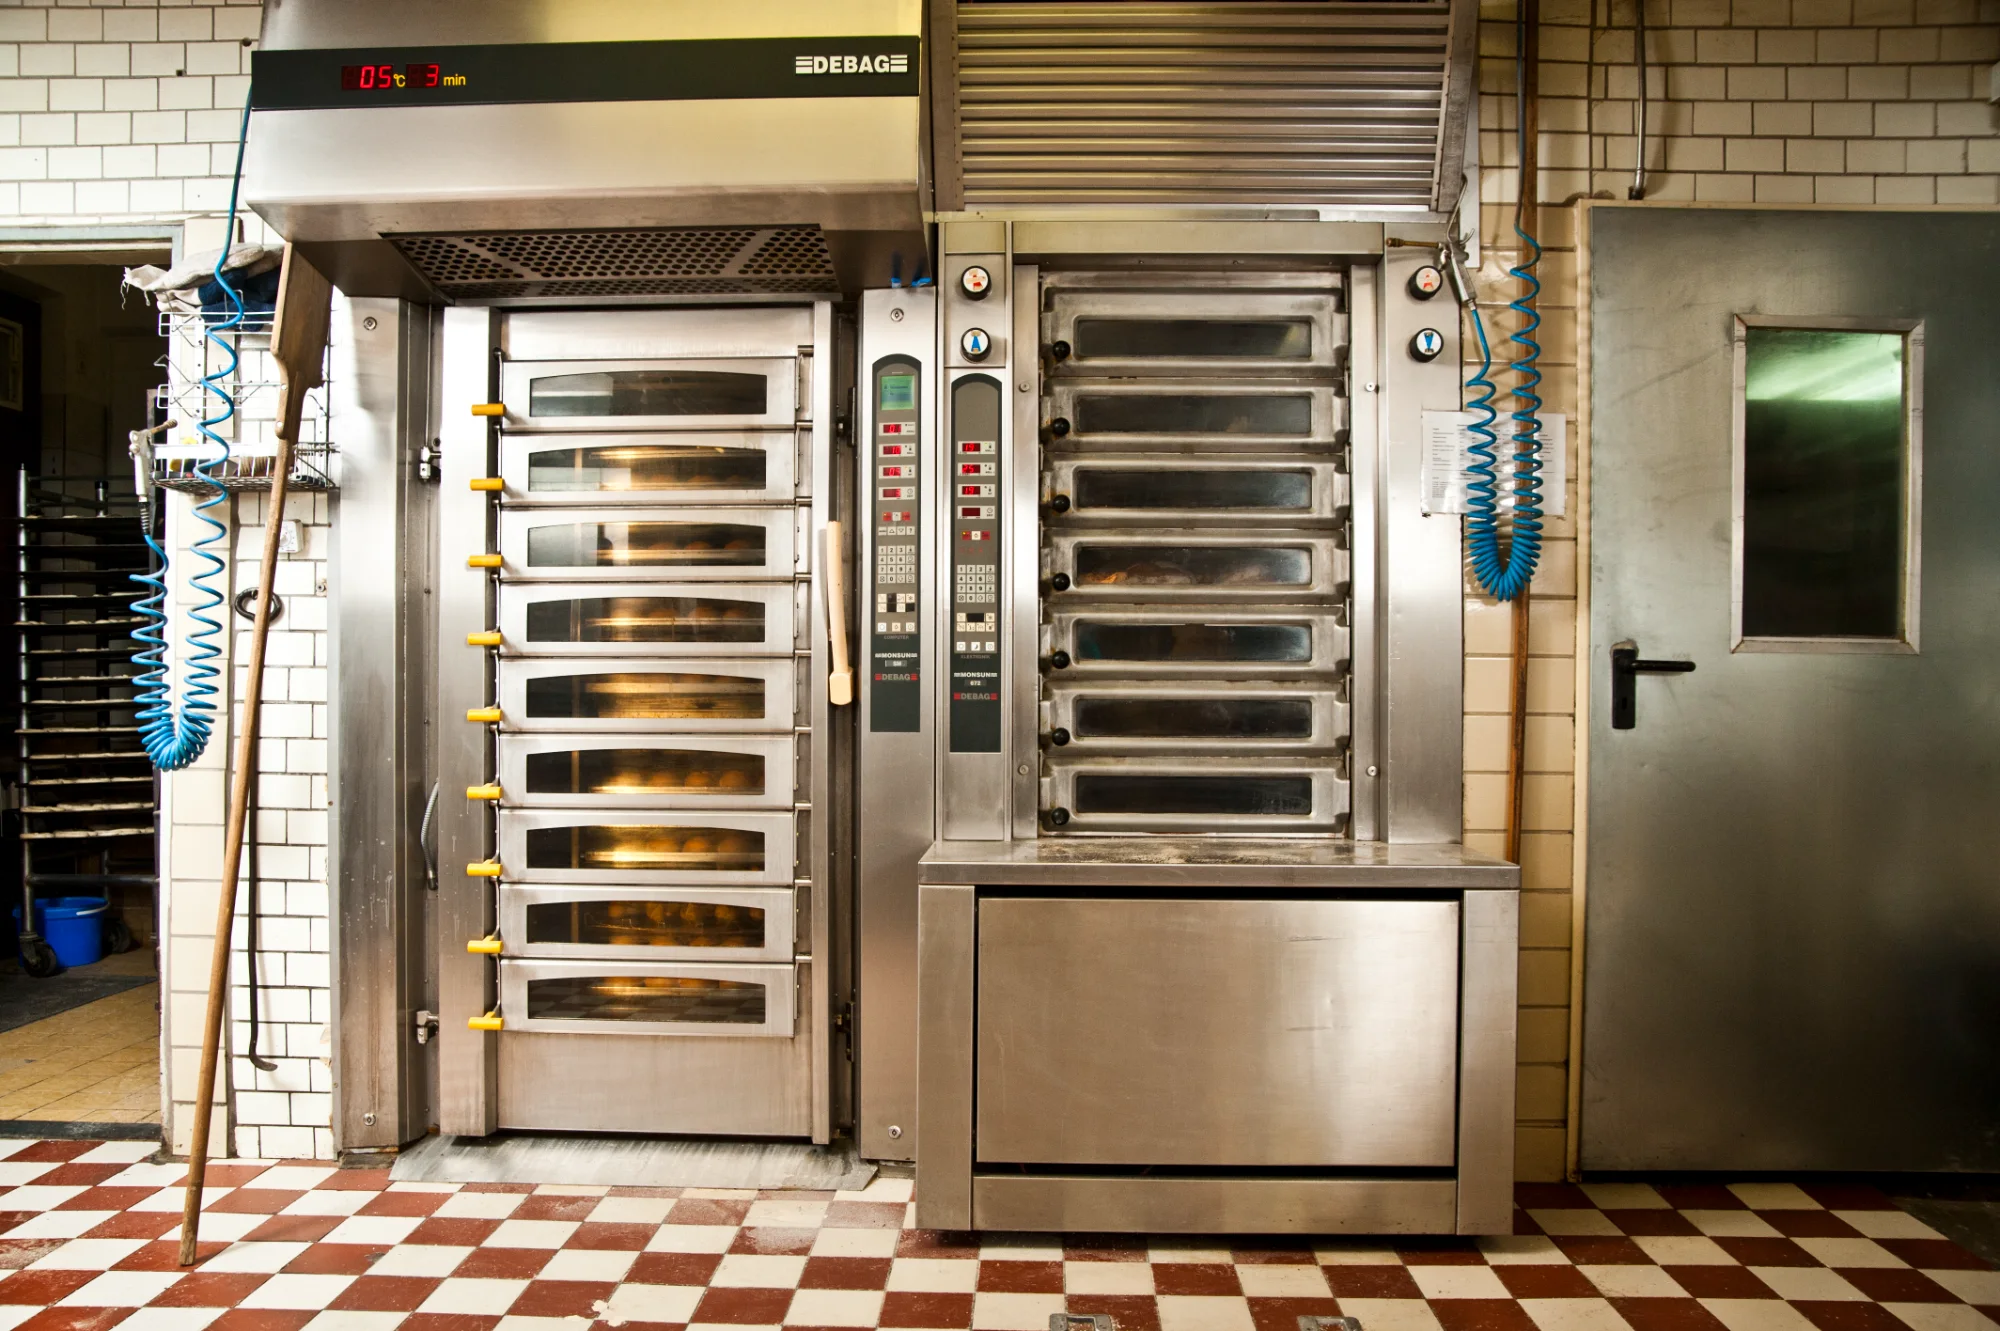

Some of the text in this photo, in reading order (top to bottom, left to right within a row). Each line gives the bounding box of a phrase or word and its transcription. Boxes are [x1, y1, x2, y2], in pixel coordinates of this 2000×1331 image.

[813, 55, 890, 74] DEBAG
[360, 65, 392, 89] 05
[425, 65, 439, 87] 3
[443, 73, 467, 86] min
